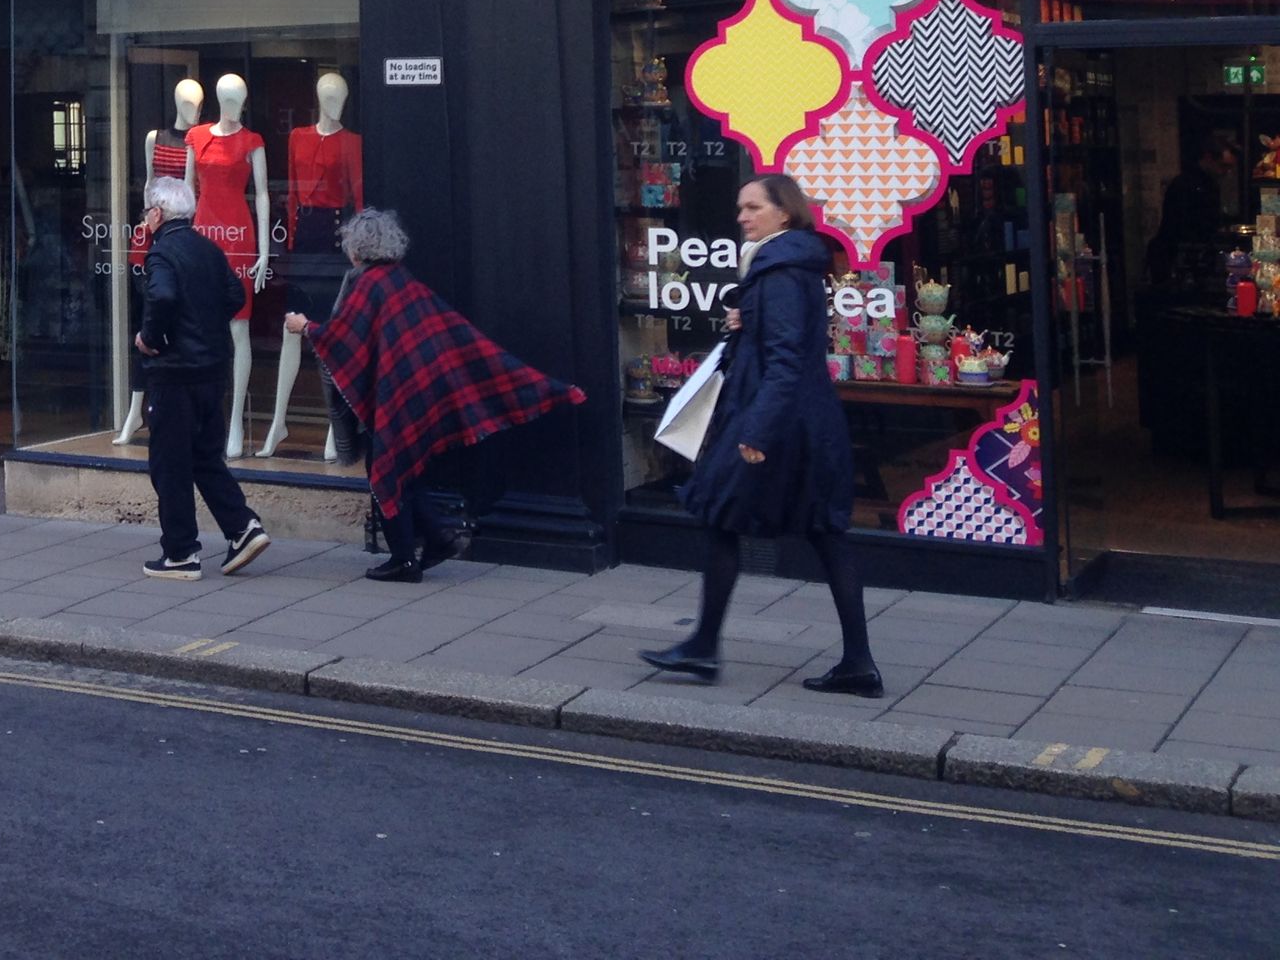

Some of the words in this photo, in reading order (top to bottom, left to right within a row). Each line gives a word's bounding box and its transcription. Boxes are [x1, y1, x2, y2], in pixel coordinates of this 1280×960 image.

[390, 63, 403, 71] No
[405, 62, 437, 72] loading
[400, 73, 416, 82] any
[630, 142, 650, 156] T2
[667, 142, 687, 156] T2
[704, 141, 725, 156] T2
[647, 227, 754, 269] Pea
[94, 262, 125, 276] sae
[234, 263, 274, 280] stoe
[671, 315, 692, 331] T2
[990, 331, 1015, 348] T2
